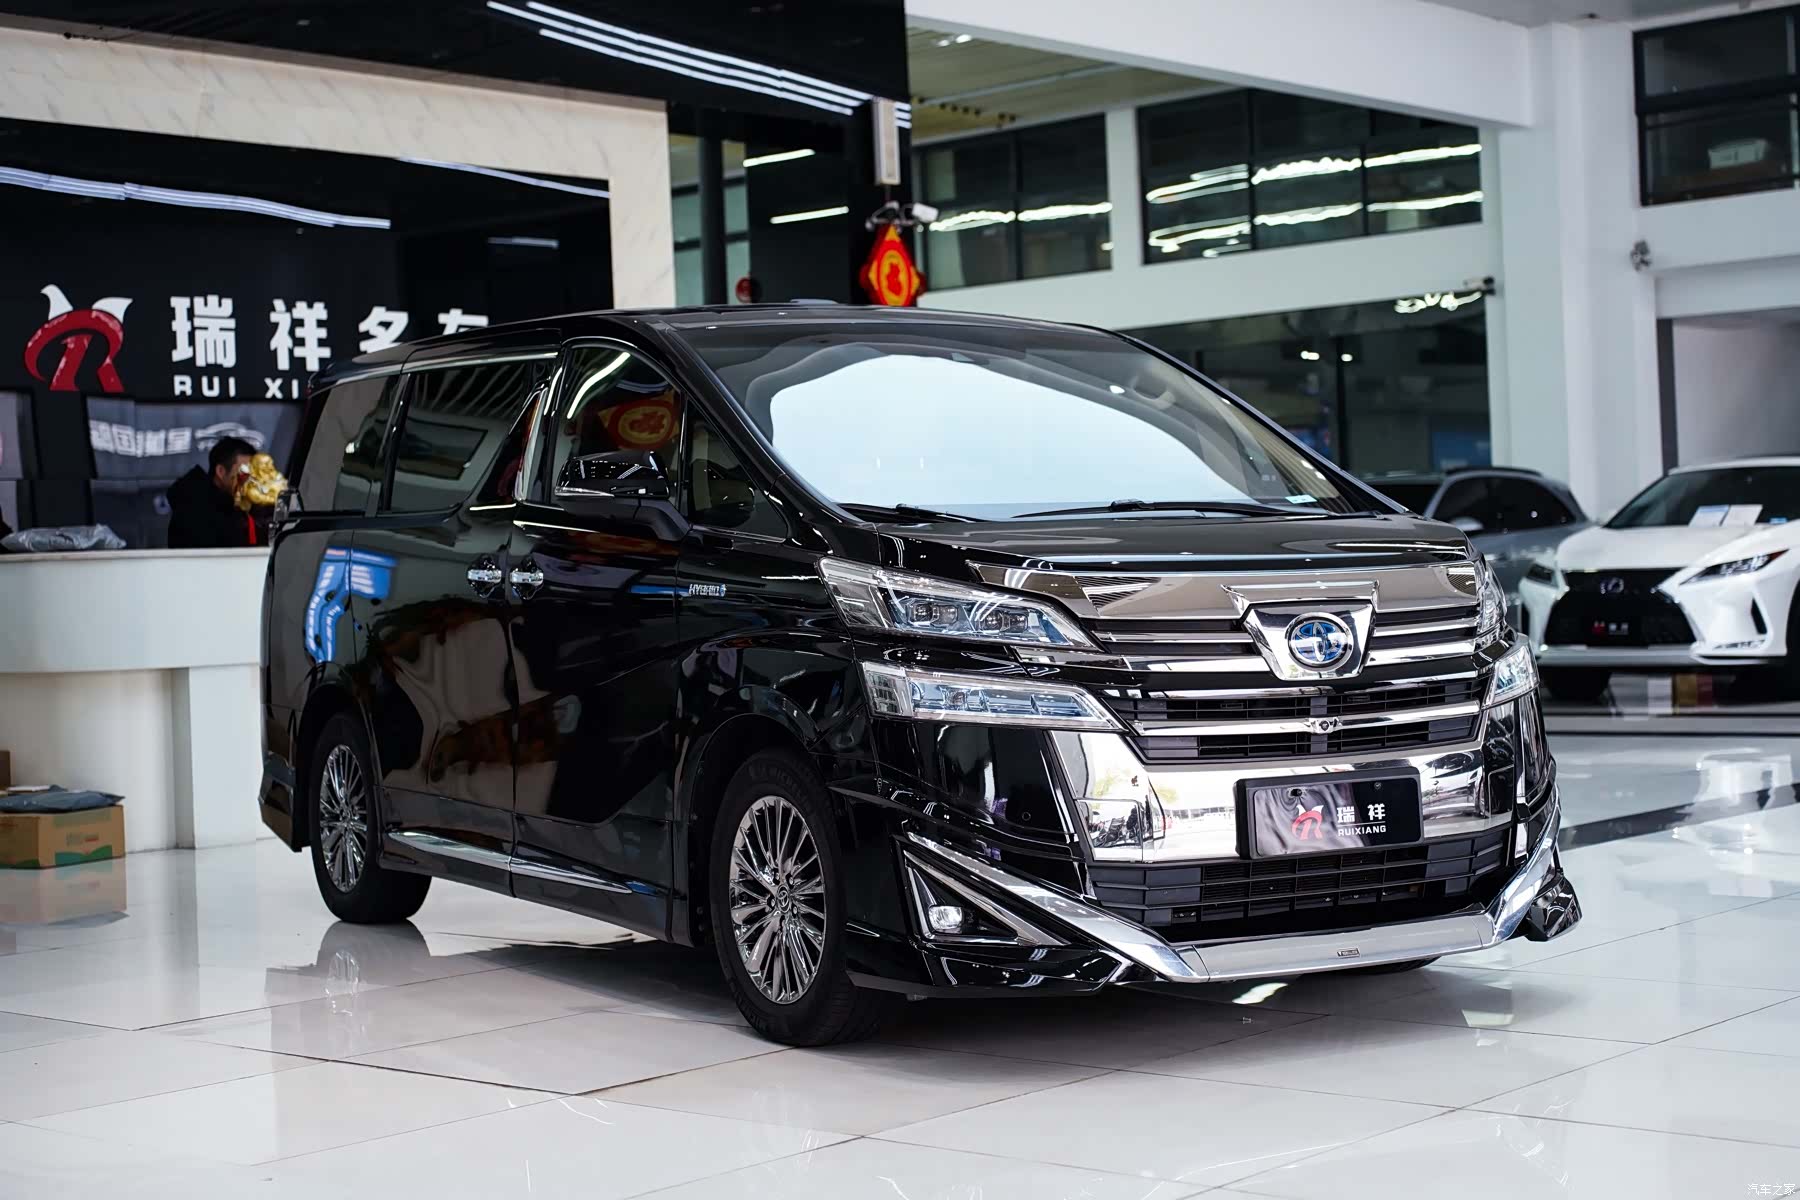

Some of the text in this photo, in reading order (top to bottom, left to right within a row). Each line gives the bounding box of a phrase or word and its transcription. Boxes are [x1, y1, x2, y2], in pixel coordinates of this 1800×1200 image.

[173, 375, 300, 399] RUI XI
[688, 583, 720, 597] HYBRID
[1336, 803, 1386, 823] 瑞祥
[1337, 825, 1387, 837] RUIXIANG
